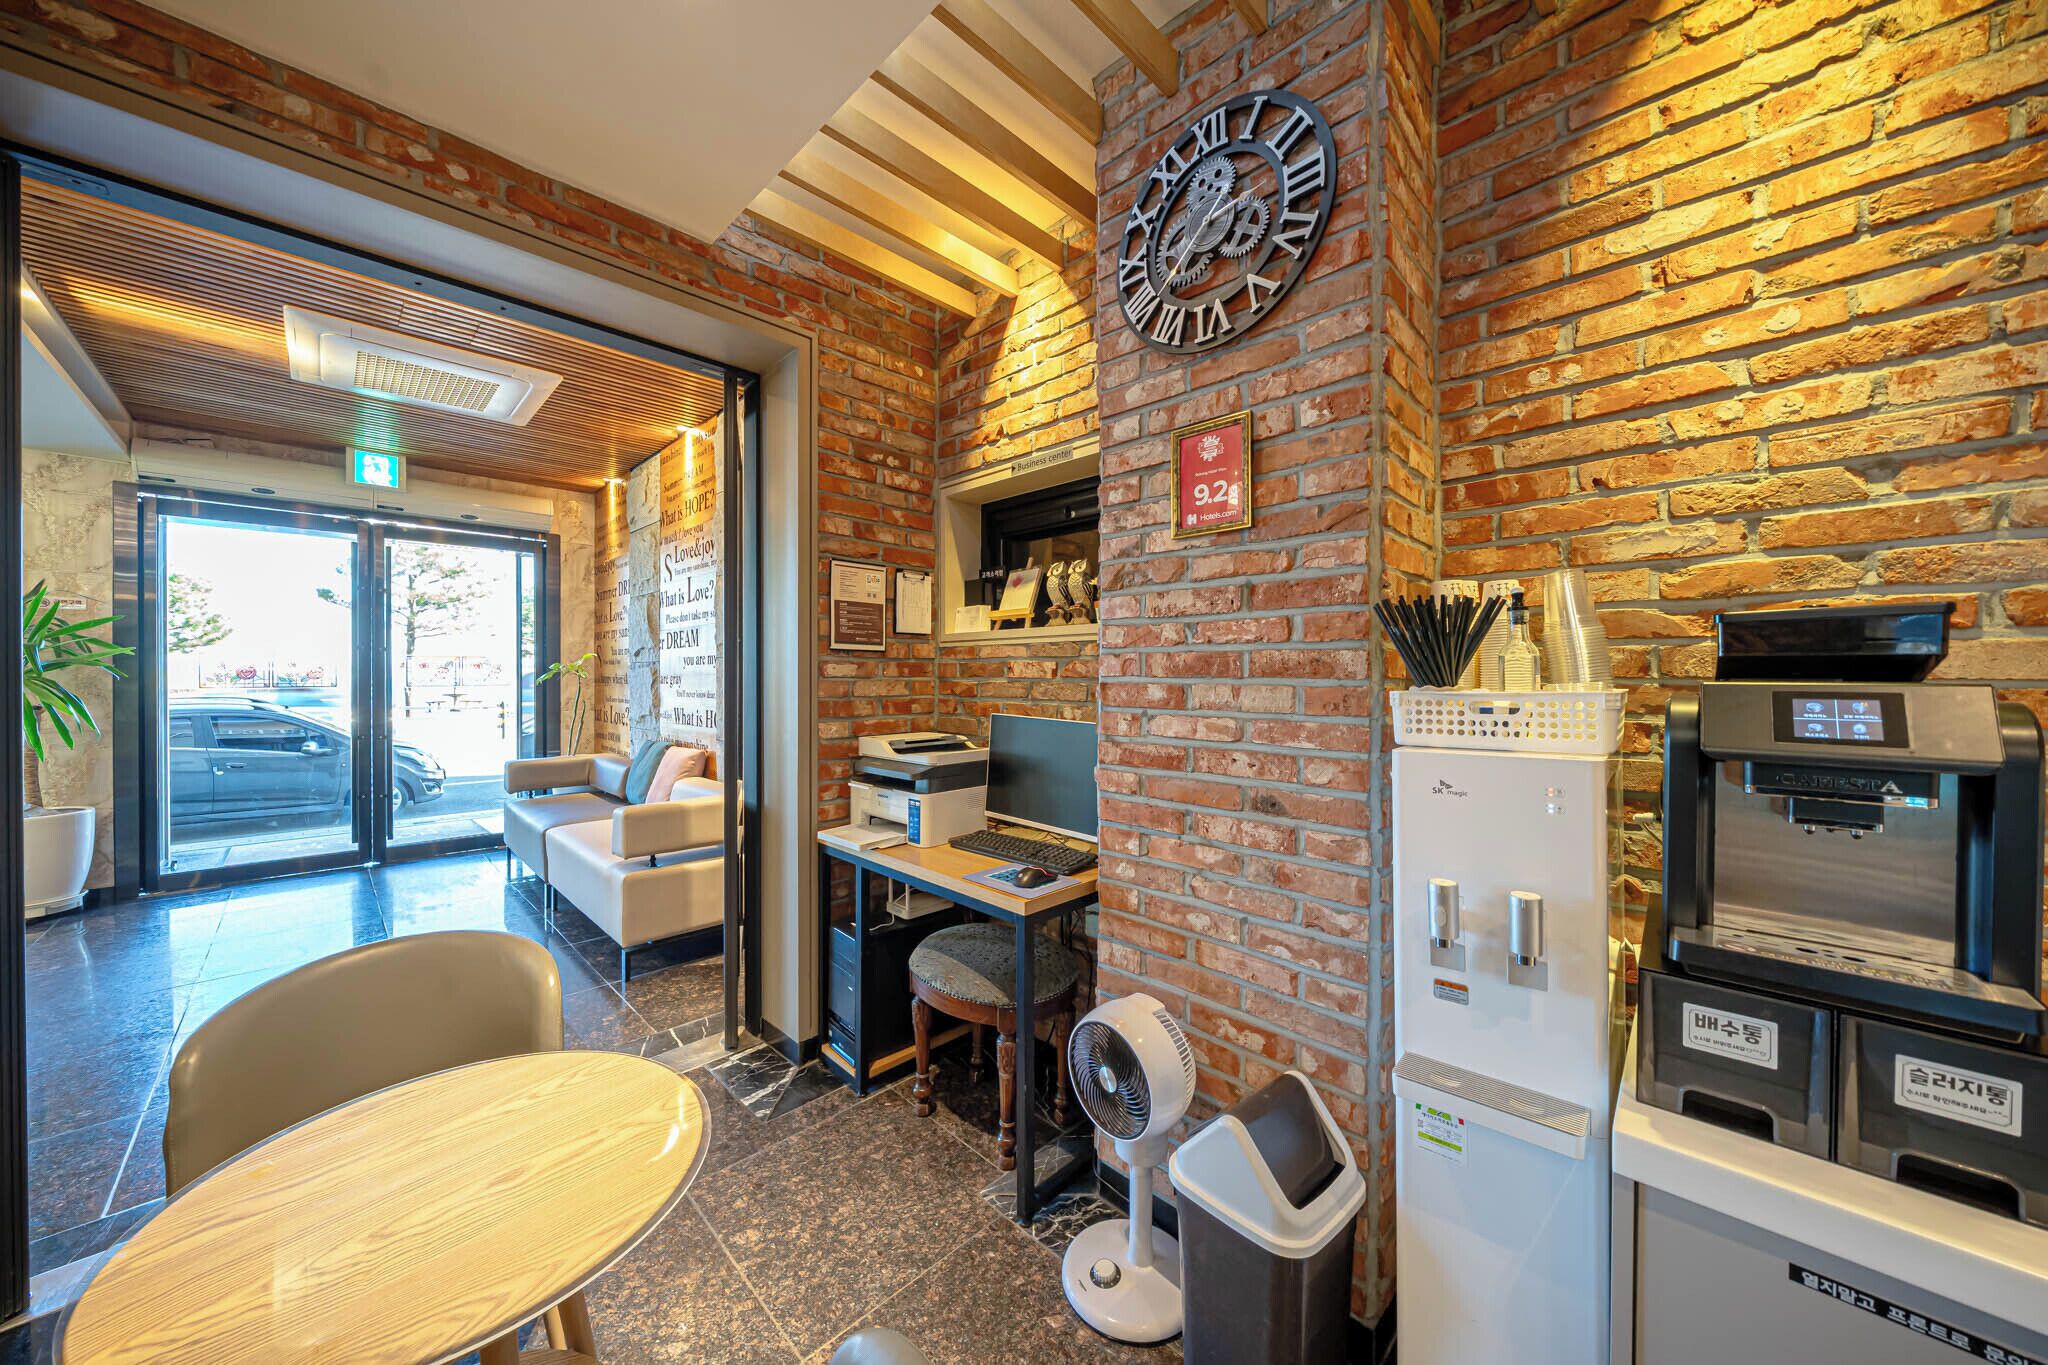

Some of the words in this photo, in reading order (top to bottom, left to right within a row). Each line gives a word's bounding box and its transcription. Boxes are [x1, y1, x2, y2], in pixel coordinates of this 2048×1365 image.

[1017, 457, 1047, 471] Business
[1048, 450, 1071, 462] center
[1193, 480, 1228, 506] 9.2
[678, 504, 683, 522] is
[685, 488, 715, 518] HOPE?
[1200, 510, 1237, 521] Hotels.com
[675, 536, 715, 563] Love&joy
[678, 588, 685, 605] is
[687, 577, 714, 603] Love?
[666, 628, 699, 649] DREAM
[683, 656, 695, 669] you
[695, 655, 706, 665] are
[660, 675, 669, 684] are
[669, 675, 681, 688] gray
[610, 705, 630, 727] Love?
[674, 707, 694, 726] What
[696, 709, 703, 727] is
[1432, 786, 1444, 794] SK
[1446, 790, 1469, 798] magic
[1694, 1012, 1762, 1045] 배수통
[1909, 1067, 2008, 1106] 슬러지통
[1801, 1271, 1877, 1312] 열지말고
[1887, 1305, 1971, 1351] 프론트로
